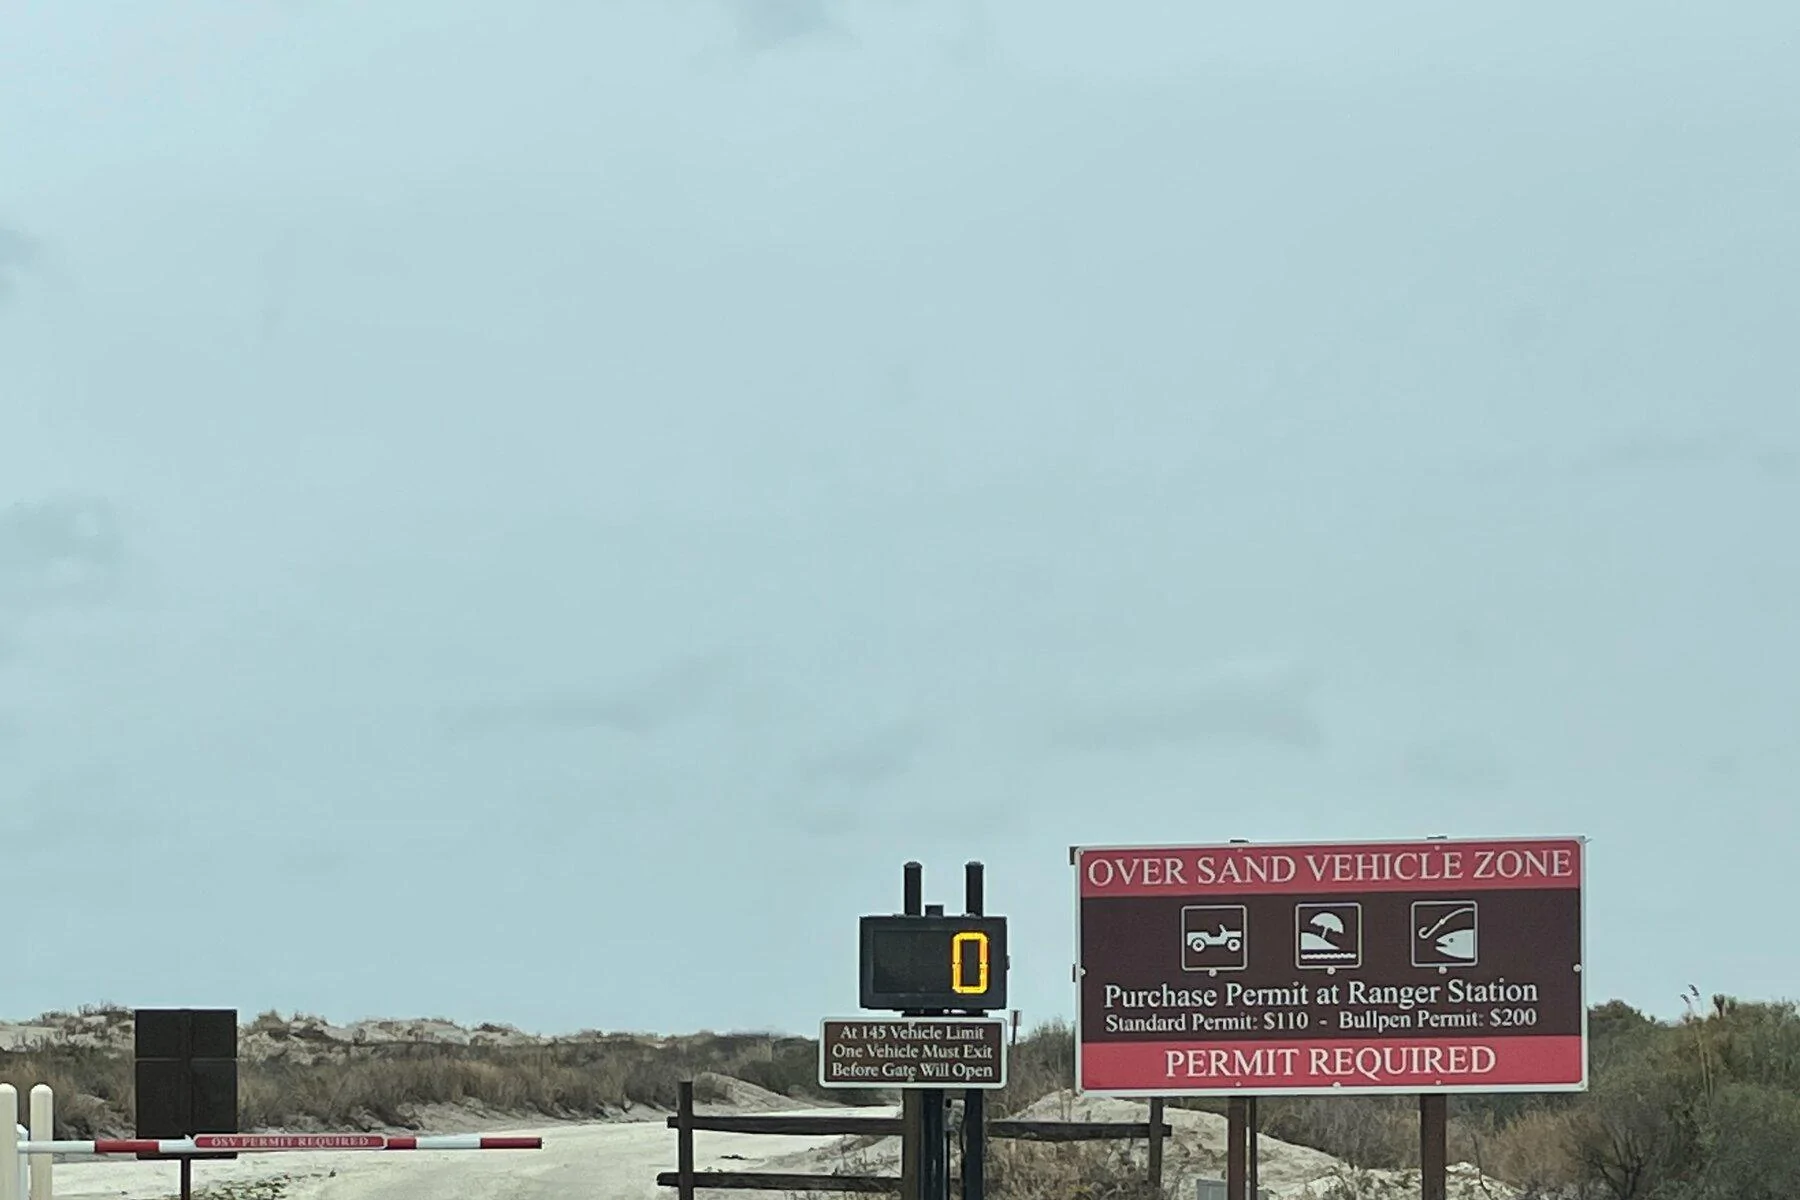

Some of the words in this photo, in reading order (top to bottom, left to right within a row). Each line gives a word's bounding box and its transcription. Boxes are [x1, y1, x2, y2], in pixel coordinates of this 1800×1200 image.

[1088, 858, 1187, 887] OVER
[1197, 855, 1296, 884] SAND
[1305, 851, 1464, 882] VEHICLE
[1473, 850, 1572, 878] ZONE
[952, 932, 988, 994] 0
[1104, 985, 1217, 1008] Purchase
[1225, 982, 1309, 1006] Permit
[1317, 985, 1340, 1004] at
[1349, 981, 1441, 1008] Ranger
[1447, 978, 1538, 1002] Station
[840, 1025, 857, 1039] At
[862, 1026, 886, 1039] 145
[890, 1026, 942, 1040] Vehicle
[946, 1026, 984, 1040] Limit
[1105, 1013, 1186, 1032] Standard
[1192, 1012, 1257, 1031] Permit:
[1263, 1012, 1308, 1030] $110
[1339, 1011, 1411, 1034] Bullpen
[1417, 1009, 1483, 1028] Permit:
[1489, 1008, 1537, 1027] $200
[832, 1044, 862, 1058] One
[867, 1044, 918, 1058] Vehicle
[923, 1044, 959, 1058] Must
[963, 1044, 992, 1058] Exit
[1165, 1050, 1299, 1077] PERMIT
[1309, 1046, 1496, 1080] REQUIRED
[832, 1063, 878, 1076] Before
[882, 1063, 916, 1077] Gate
[921, 1063, 948, 1076] Will
[952, 1064, 993, 1081] Open
[211, 1137, 236, 1147] OSV
[242, 1137, 293, 1147] PERMIT
[298, 1136, 369, 1146] REQUIRED
